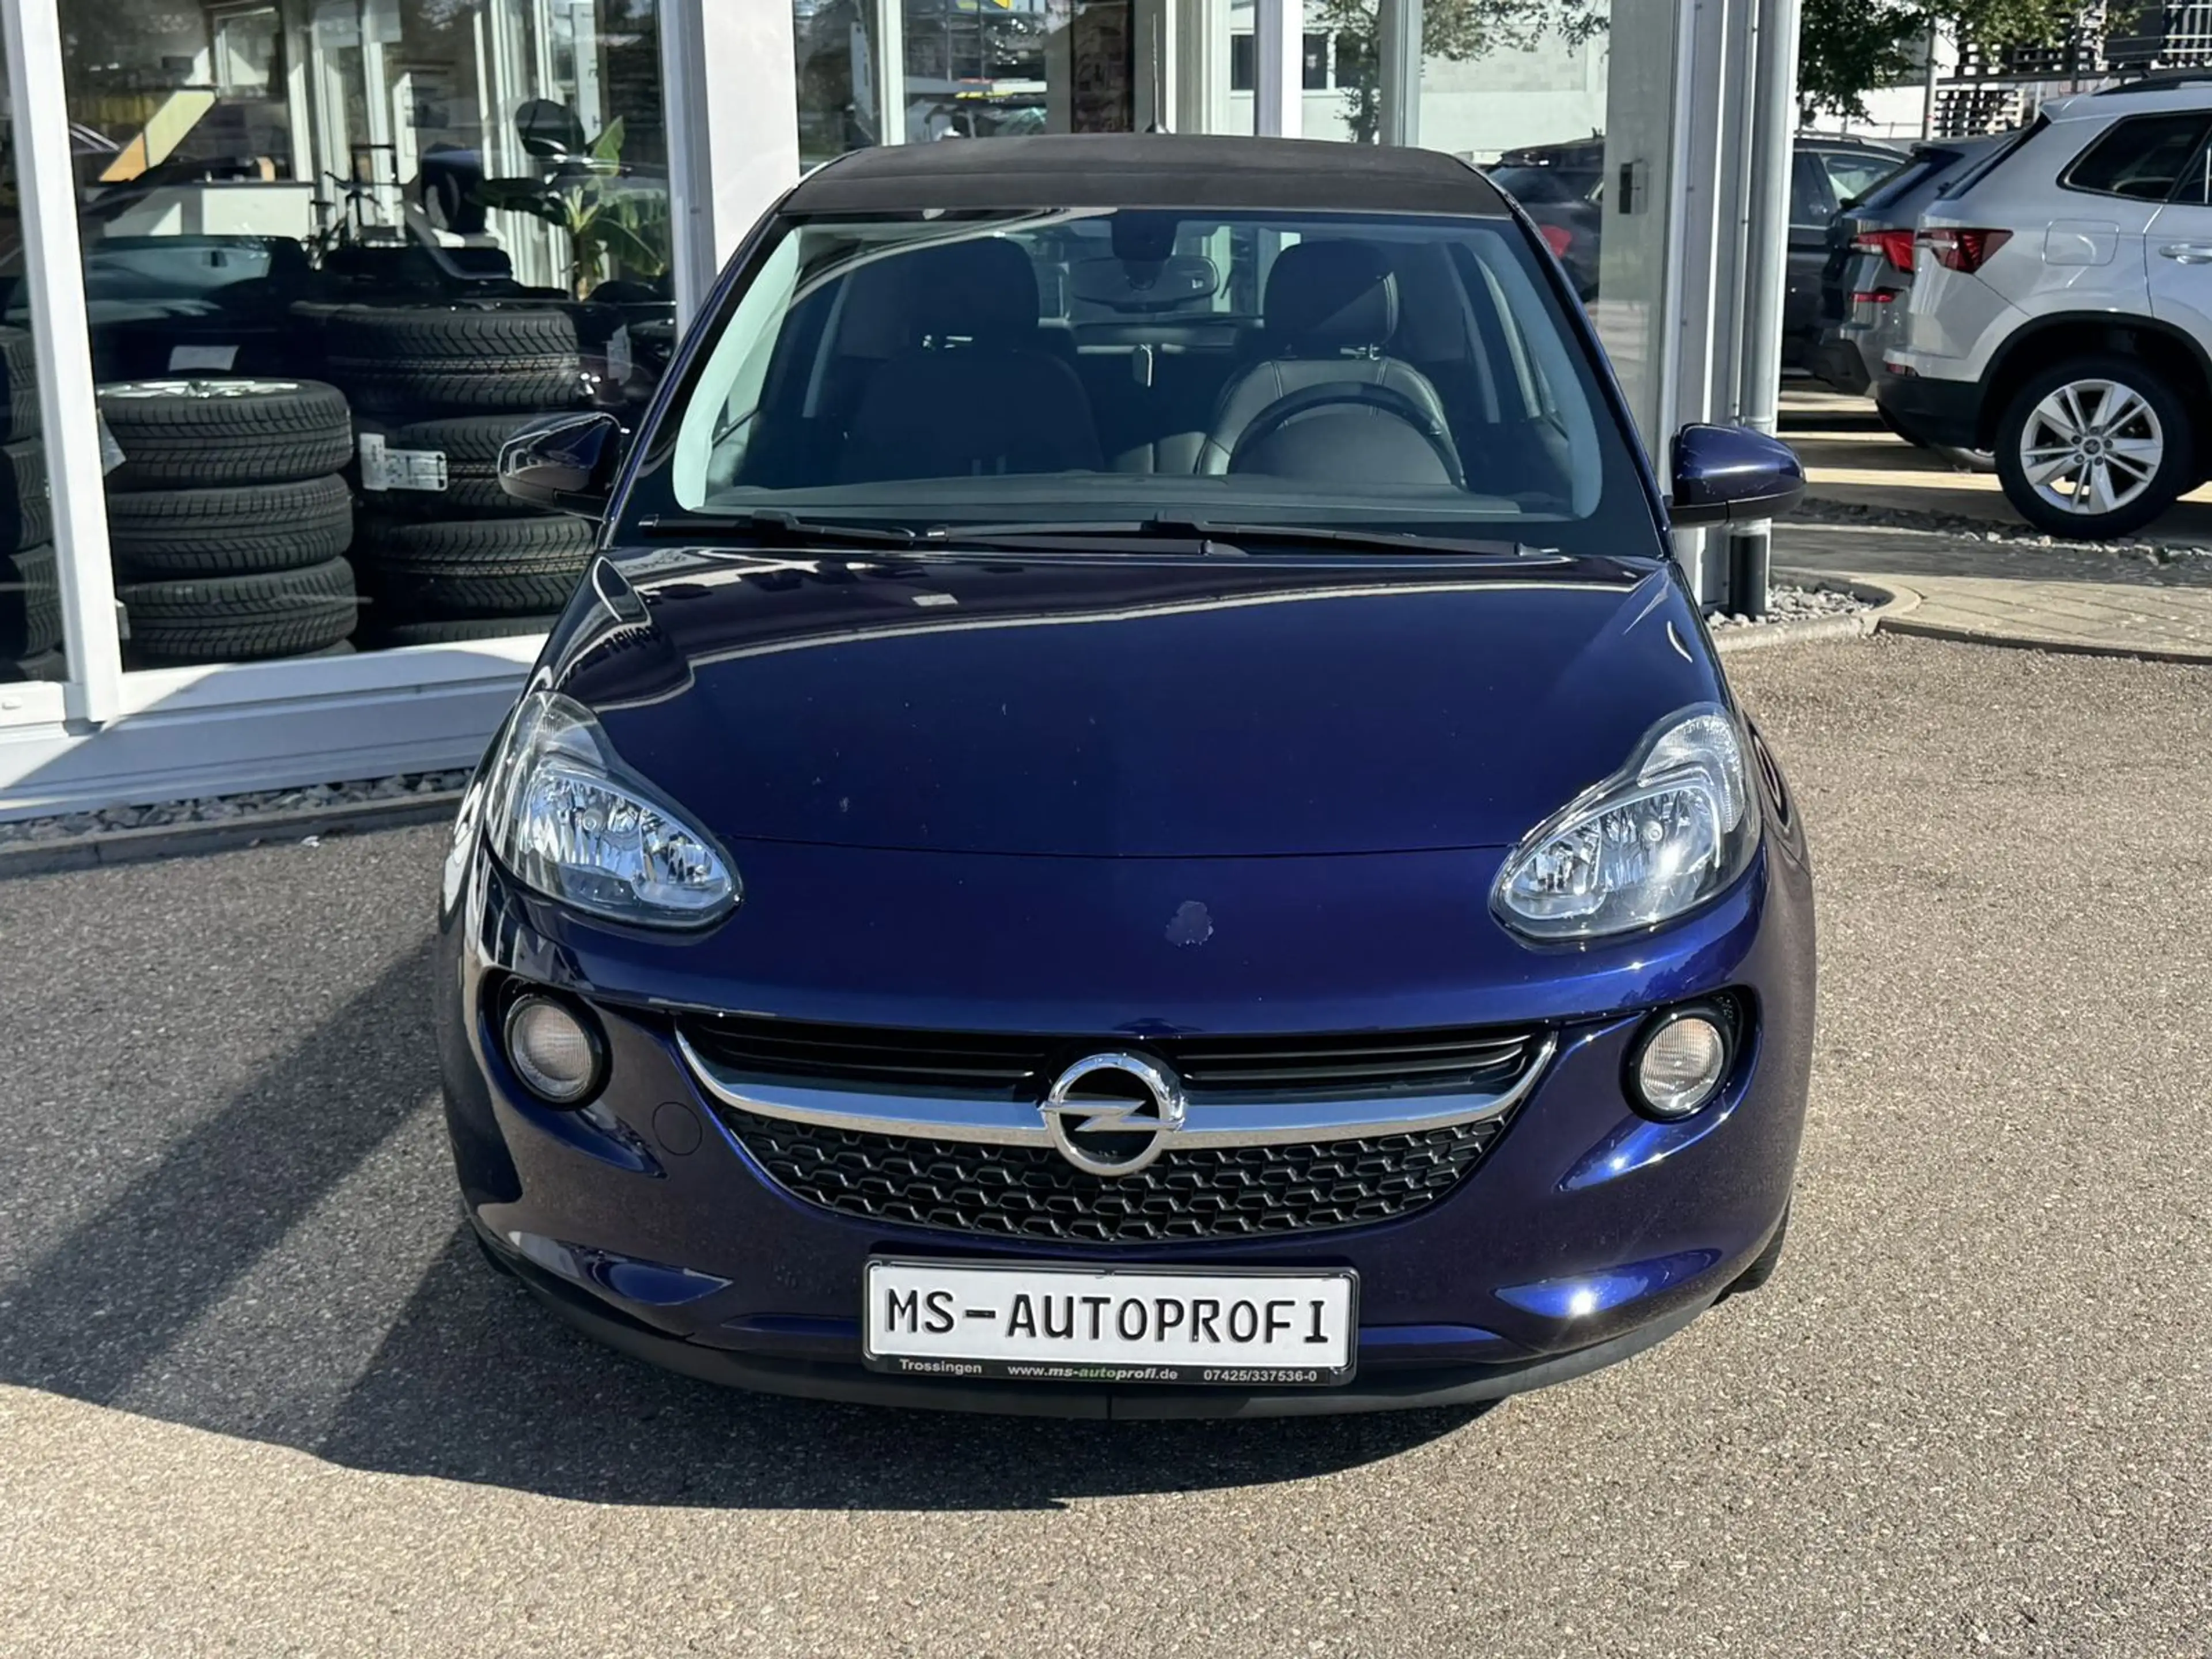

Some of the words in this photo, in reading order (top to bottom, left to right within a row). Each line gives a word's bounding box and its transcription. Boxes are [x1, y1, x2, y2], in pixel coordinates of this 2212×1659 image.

[887, 1288, 1328, 1343] MS-AUTOPROFI
[899, 1359, 982, 1374] Trossingen
[1007, 1365, 1177, 1380] www.ms-autoprofi.de
[1203, 1369, 1317, 1382] 07425/337536-0
